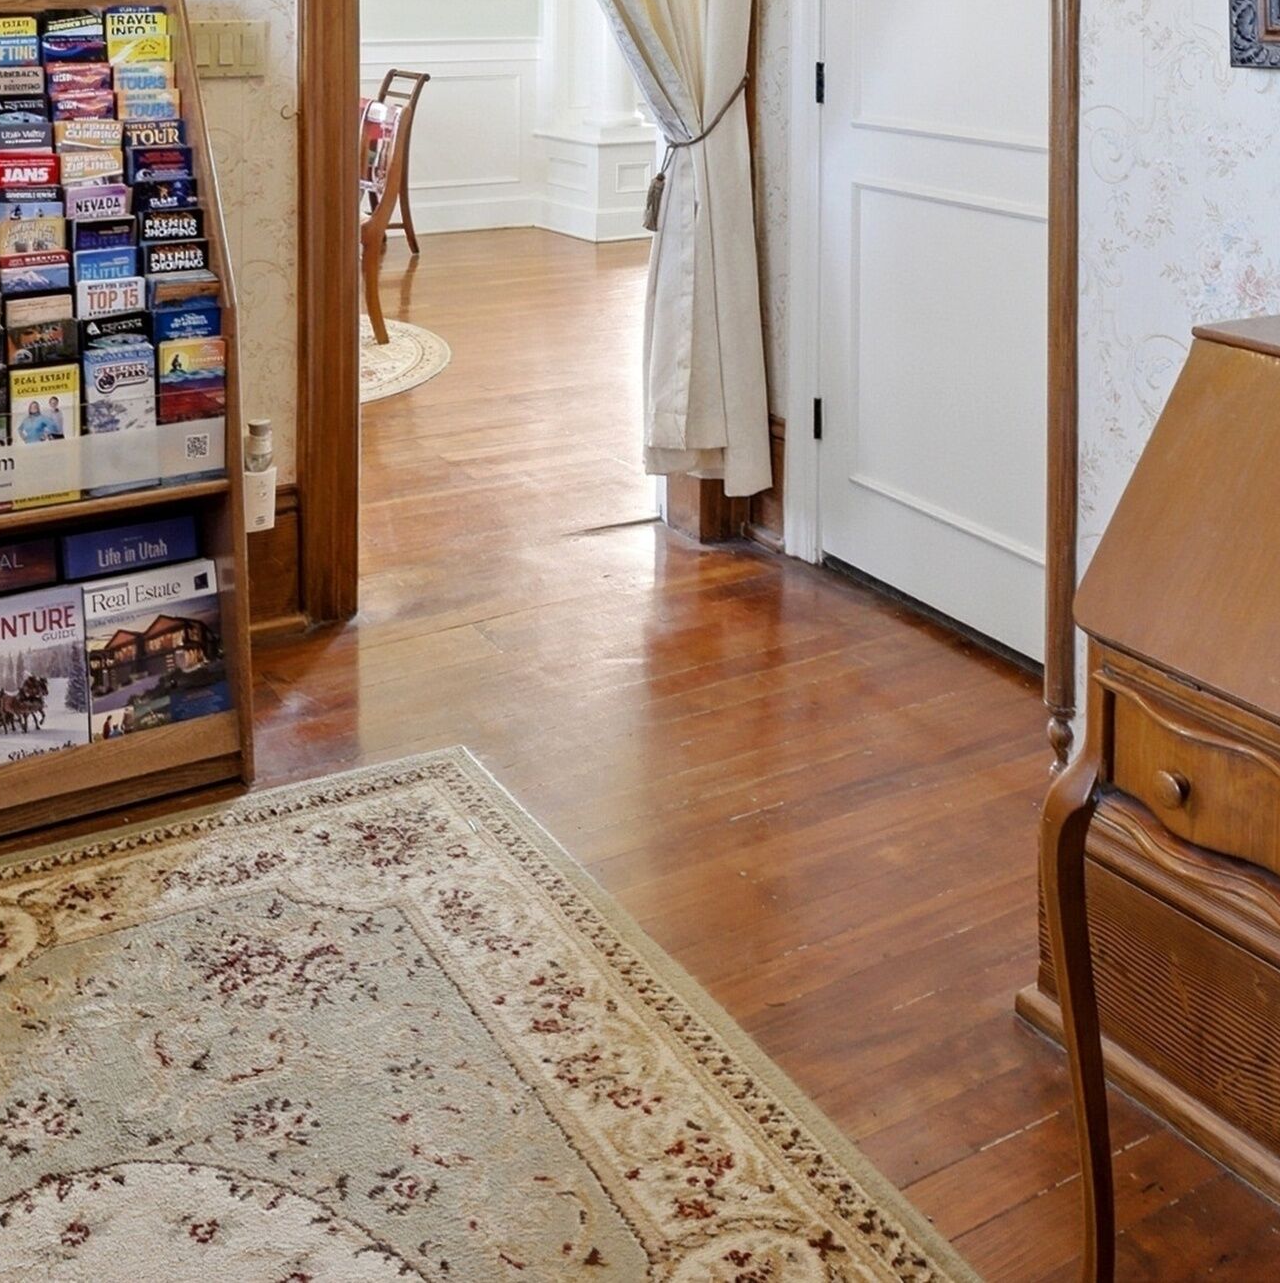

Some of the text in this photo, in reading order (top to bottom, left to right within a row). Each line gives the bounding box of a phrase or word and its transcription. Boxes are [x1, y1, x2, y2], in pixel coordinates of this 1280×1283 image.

[110, 15, 158, 25] TRAVEL
[127, 129, 180, 144] TOUR
[1, 168, 50, 182] JANS
[76, 197, 120, 213] NEVADA
[87, 288, 138, 309] TOP 15
[14, 372, 71, 385] REAL ESTATE
[16, 386, 39, 394] LOCAL
[124, 546, 136, 562] in
[138, 538, 168, 560] Utah
[92, 581, 181, 613] Real Estate
[42, 628, 77, 642] GUIDE
